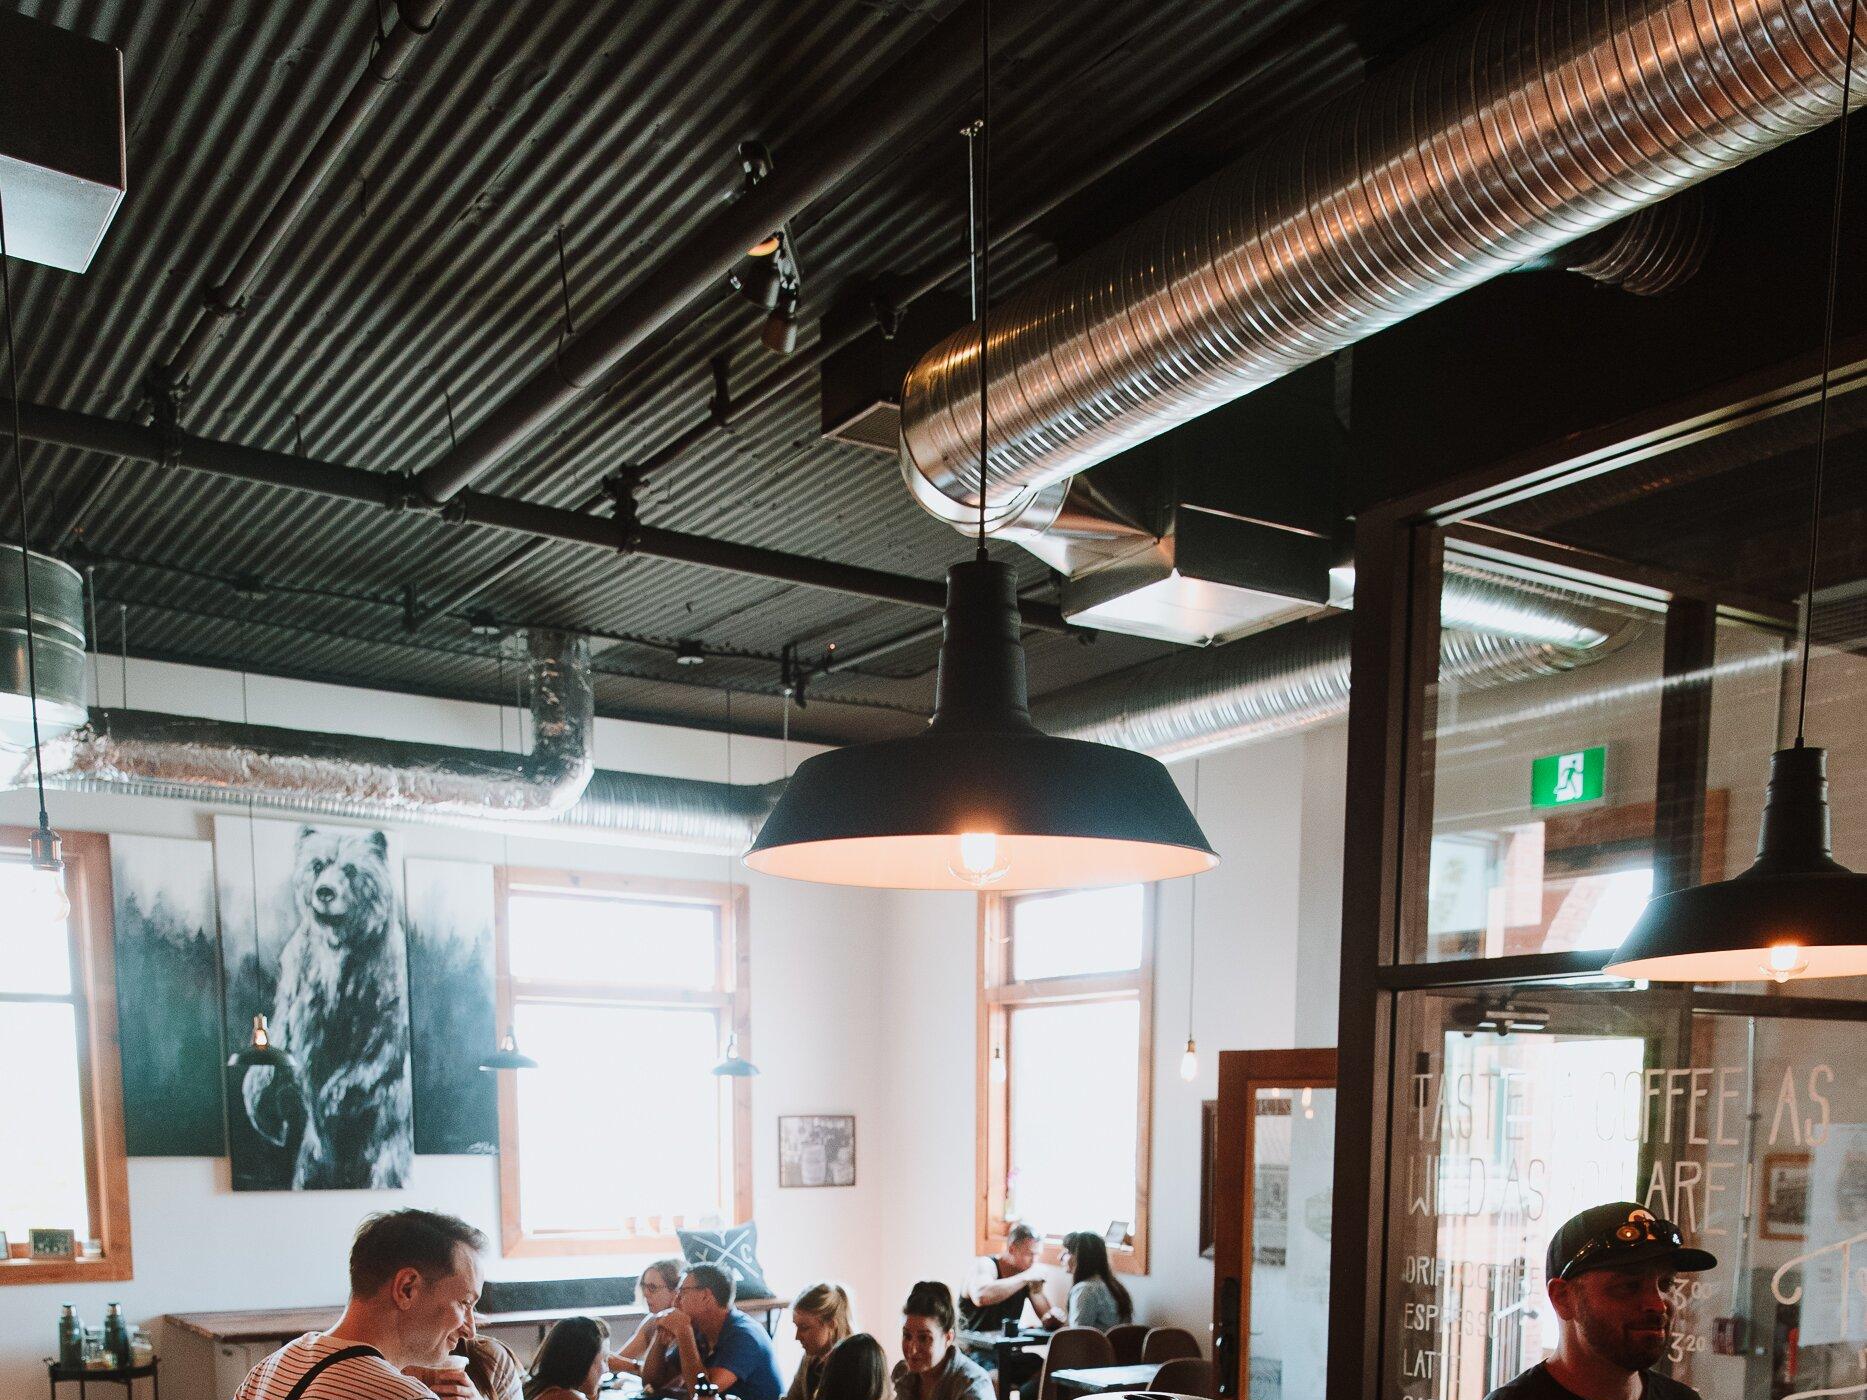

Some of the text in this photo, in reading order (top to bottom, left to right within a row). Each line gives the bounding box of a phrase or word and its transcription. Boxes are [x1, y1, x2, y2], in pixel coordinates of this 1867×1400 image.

[1412, 1073, 1526, 1142] TASTE
[1595, 1067, 1743, 1146] COFFEE
[1768, 1064, 1835, 1147] AS
[1409, 1154, 1486, 1217] WID
[1500, 1157, 1546, 1222] AS
